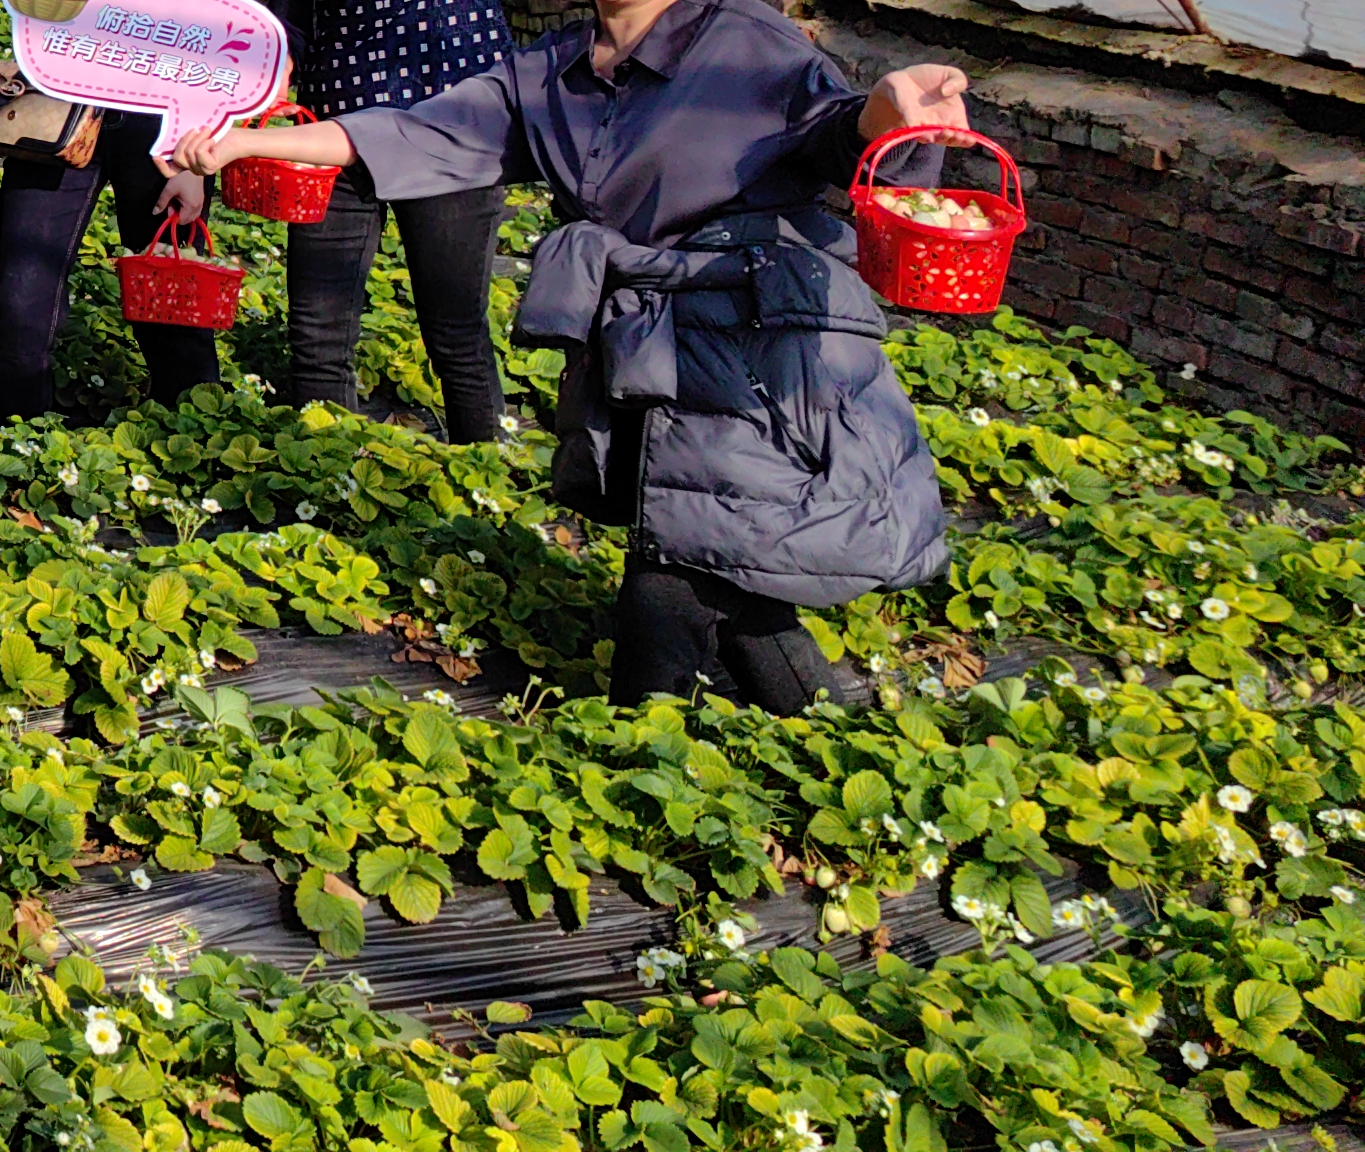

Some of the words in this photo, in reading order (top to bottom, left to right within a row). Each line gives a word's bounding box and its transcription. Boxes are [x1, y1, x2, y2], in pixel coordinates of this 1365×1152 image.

[94, 3, 212, 55] 俯拾自然
[41, 25, 242, 97] 惟有生活最珍贵
